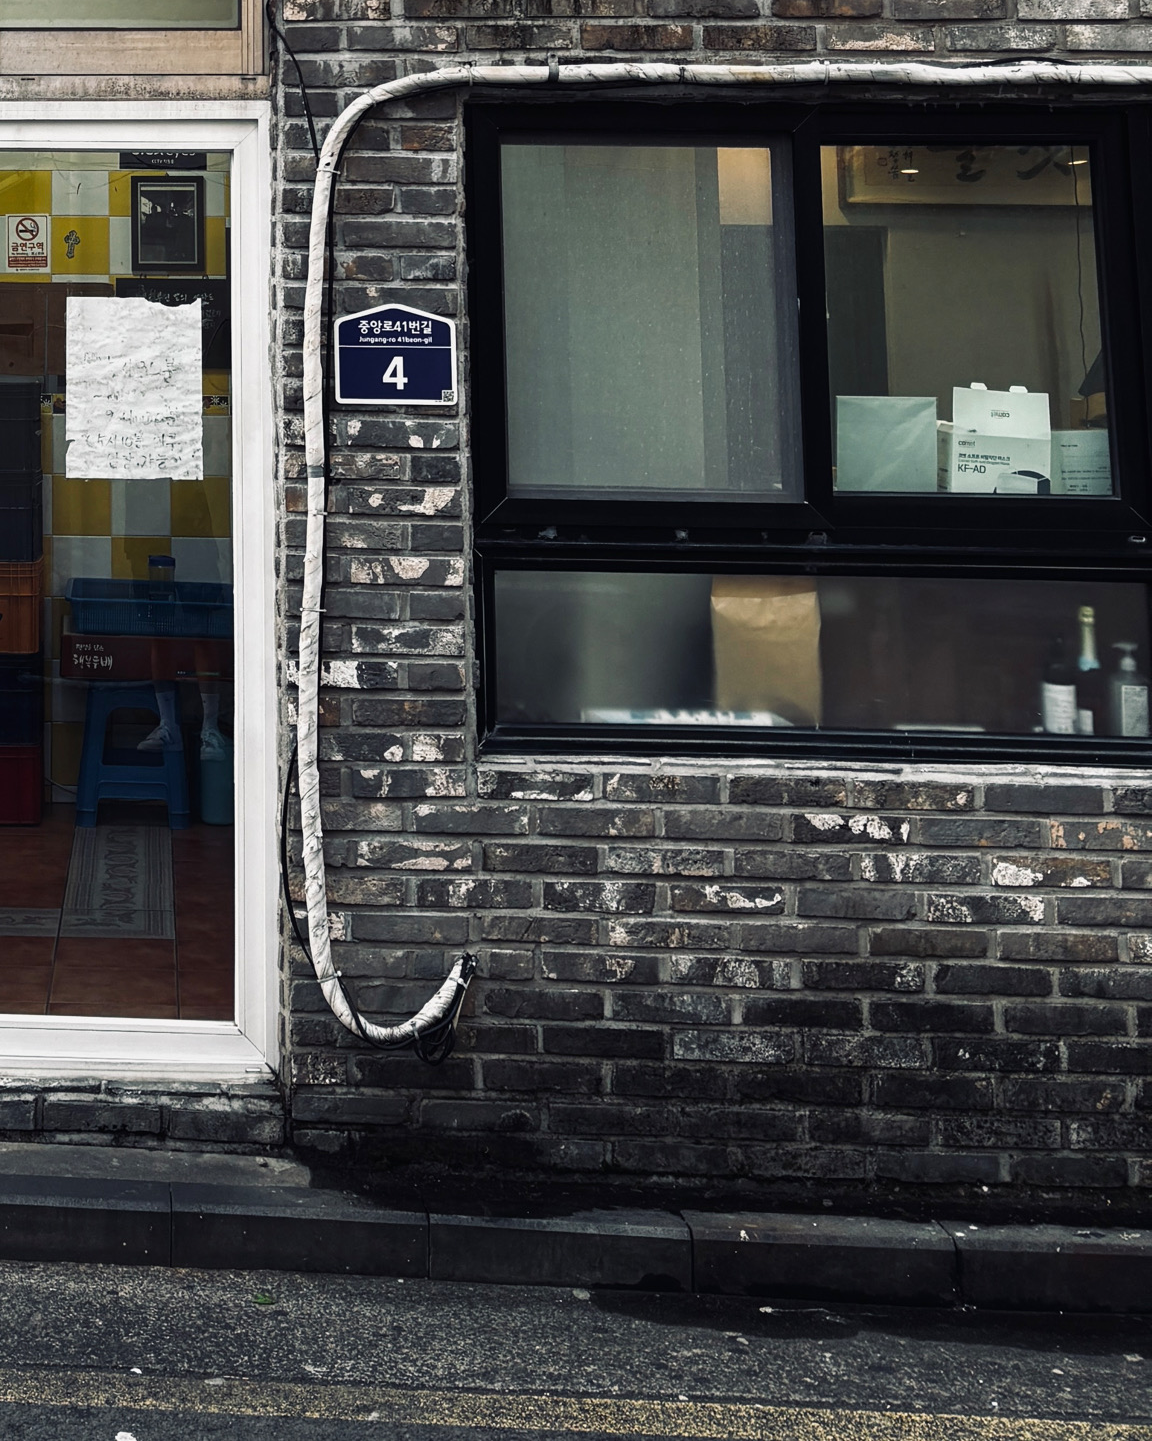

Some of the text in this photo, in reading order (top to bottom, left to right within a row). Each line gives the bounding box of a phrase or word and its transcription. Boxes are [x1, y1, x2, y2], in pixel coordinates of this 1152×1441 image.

[11, 242, 44, 253] 금연구역
[358, 320, 433, 334] 중앙로41번길
[359, 336, 433, 344] Jungang-ro 41beon-gil
[382, 356, 409, 390] 4
[957, 463, 986, 474] KF-AD
